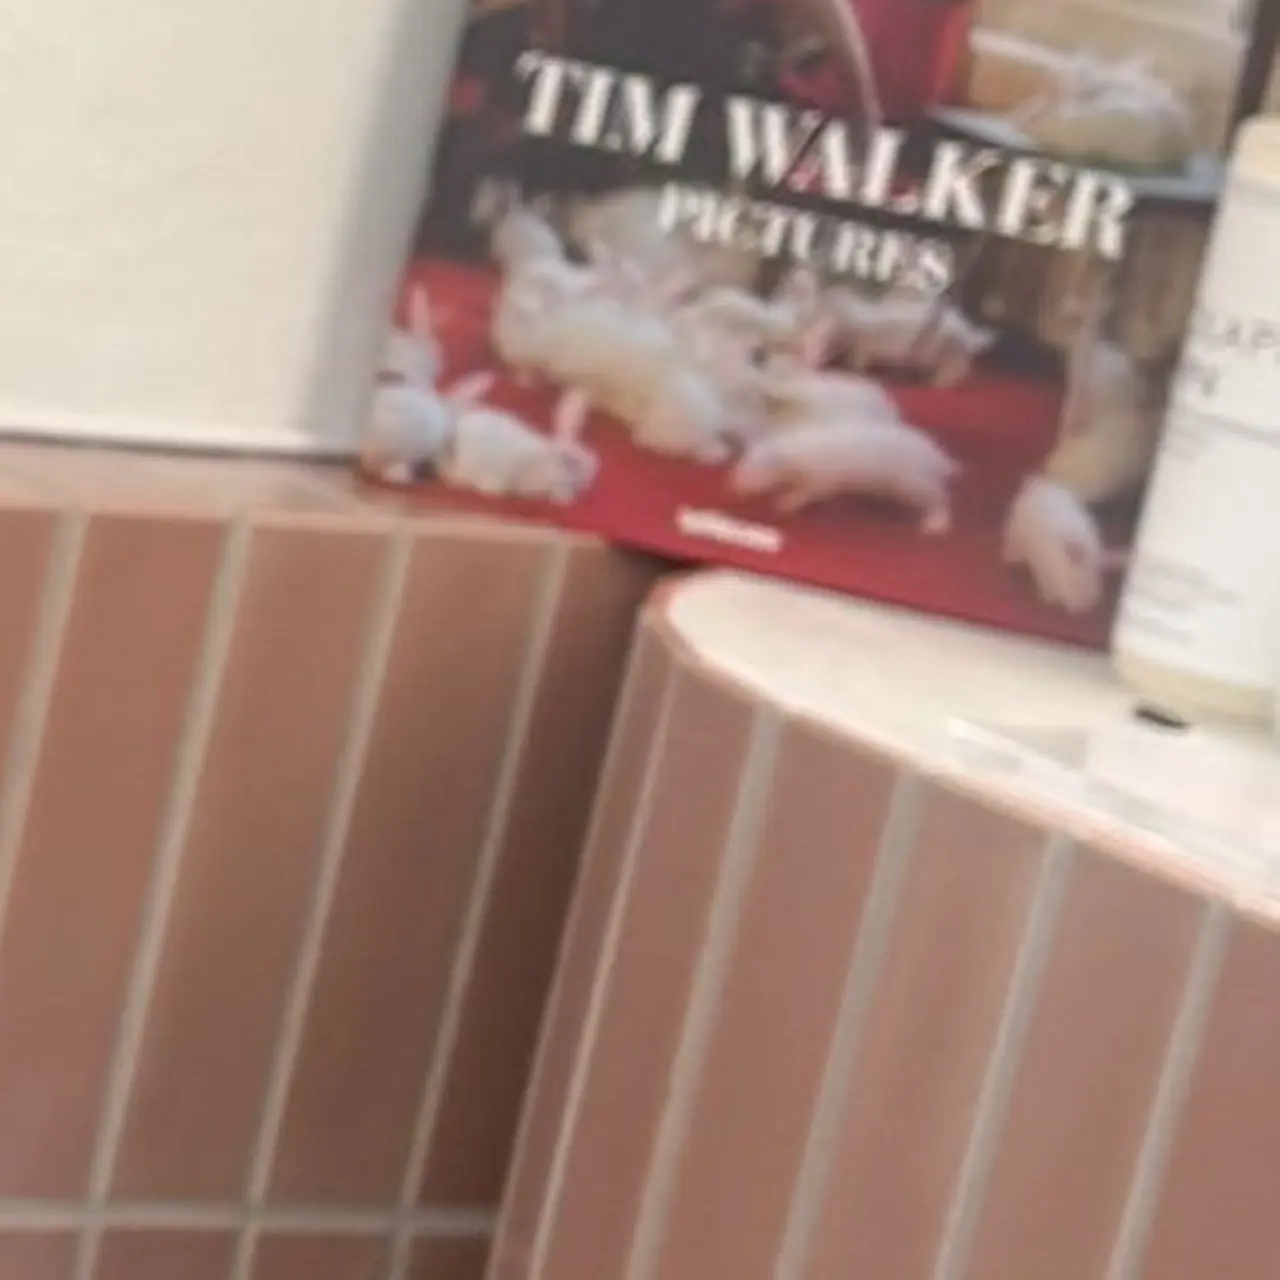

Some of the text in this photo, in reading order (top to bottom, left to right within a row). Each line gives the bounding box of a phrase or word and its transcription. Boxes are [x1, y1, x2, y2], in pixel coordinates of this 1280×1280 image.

[516, 52, 1136, 261] TIM WALKER
[657, 182, 954, 292] PICTURES
